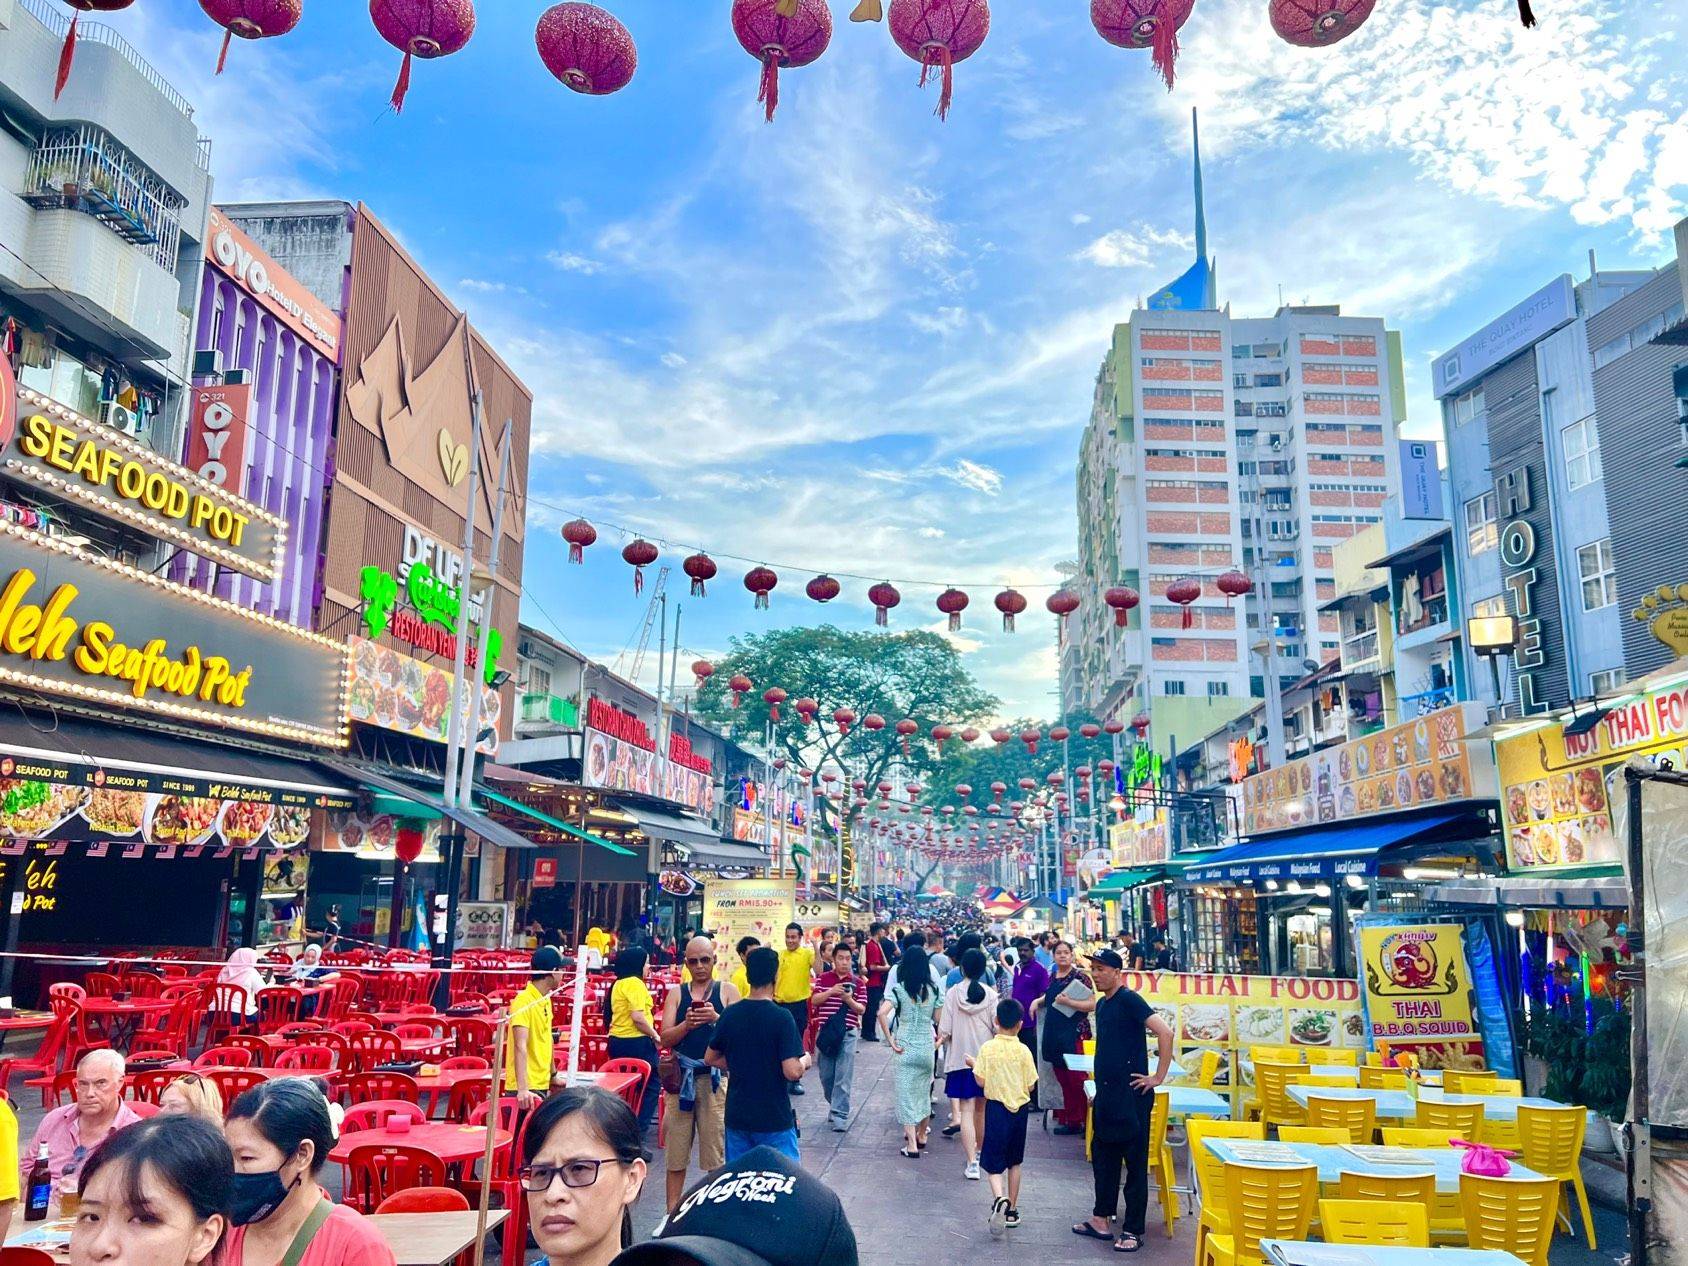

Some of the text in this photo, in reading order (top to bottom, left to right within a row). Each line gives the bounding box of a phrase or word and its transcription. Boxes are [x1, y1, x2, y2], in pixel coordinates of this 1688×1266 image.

[212, 232, 268, 294] OYO
[267, 284, 292, 312] Hotel
[301, 310, 337, 348] Elegant
[1468, 339, 1488, 356] THE
[1489, 318, 1517, 343] QUAY
[1517, 295, 1555, 324] HOTEL
[198, 401, 233, 485] OYO
[21, 414, 250, 546] SEAFOOD POT
[1496, 465, 1550, 718] HOTEL
[393, 608, 437, 653] RESTORAN
[75, 621, 202, 698] Seafood
[199, 655, 253, 708] Pot
[1607, 702, 1651, 746] THAI
[15, 764, 51, 777] SEAFOOD
[53, 770, 69, 779] POT
[106, 775, 135, 787] SEAFOOD
[136, 780, 149, 788] POT
[163, 781, 181, 791] SINCE
[1290, 863, 1321, 877] Malaysian Food
[1335, 861, 1367, 873] Local Cuisine
[33, 894, 56, 910] Pot
[716, 900, 737, 908] FROM
[1171, 974, 1250, 997] THAI
[1269, 977, 1360, 1001] FOOD
[1393, 1000, 1443, 1019] THAI
[1418, 1020, 1470, 1036] SQUID
[672, 1172, 797, 1223] Negroni
